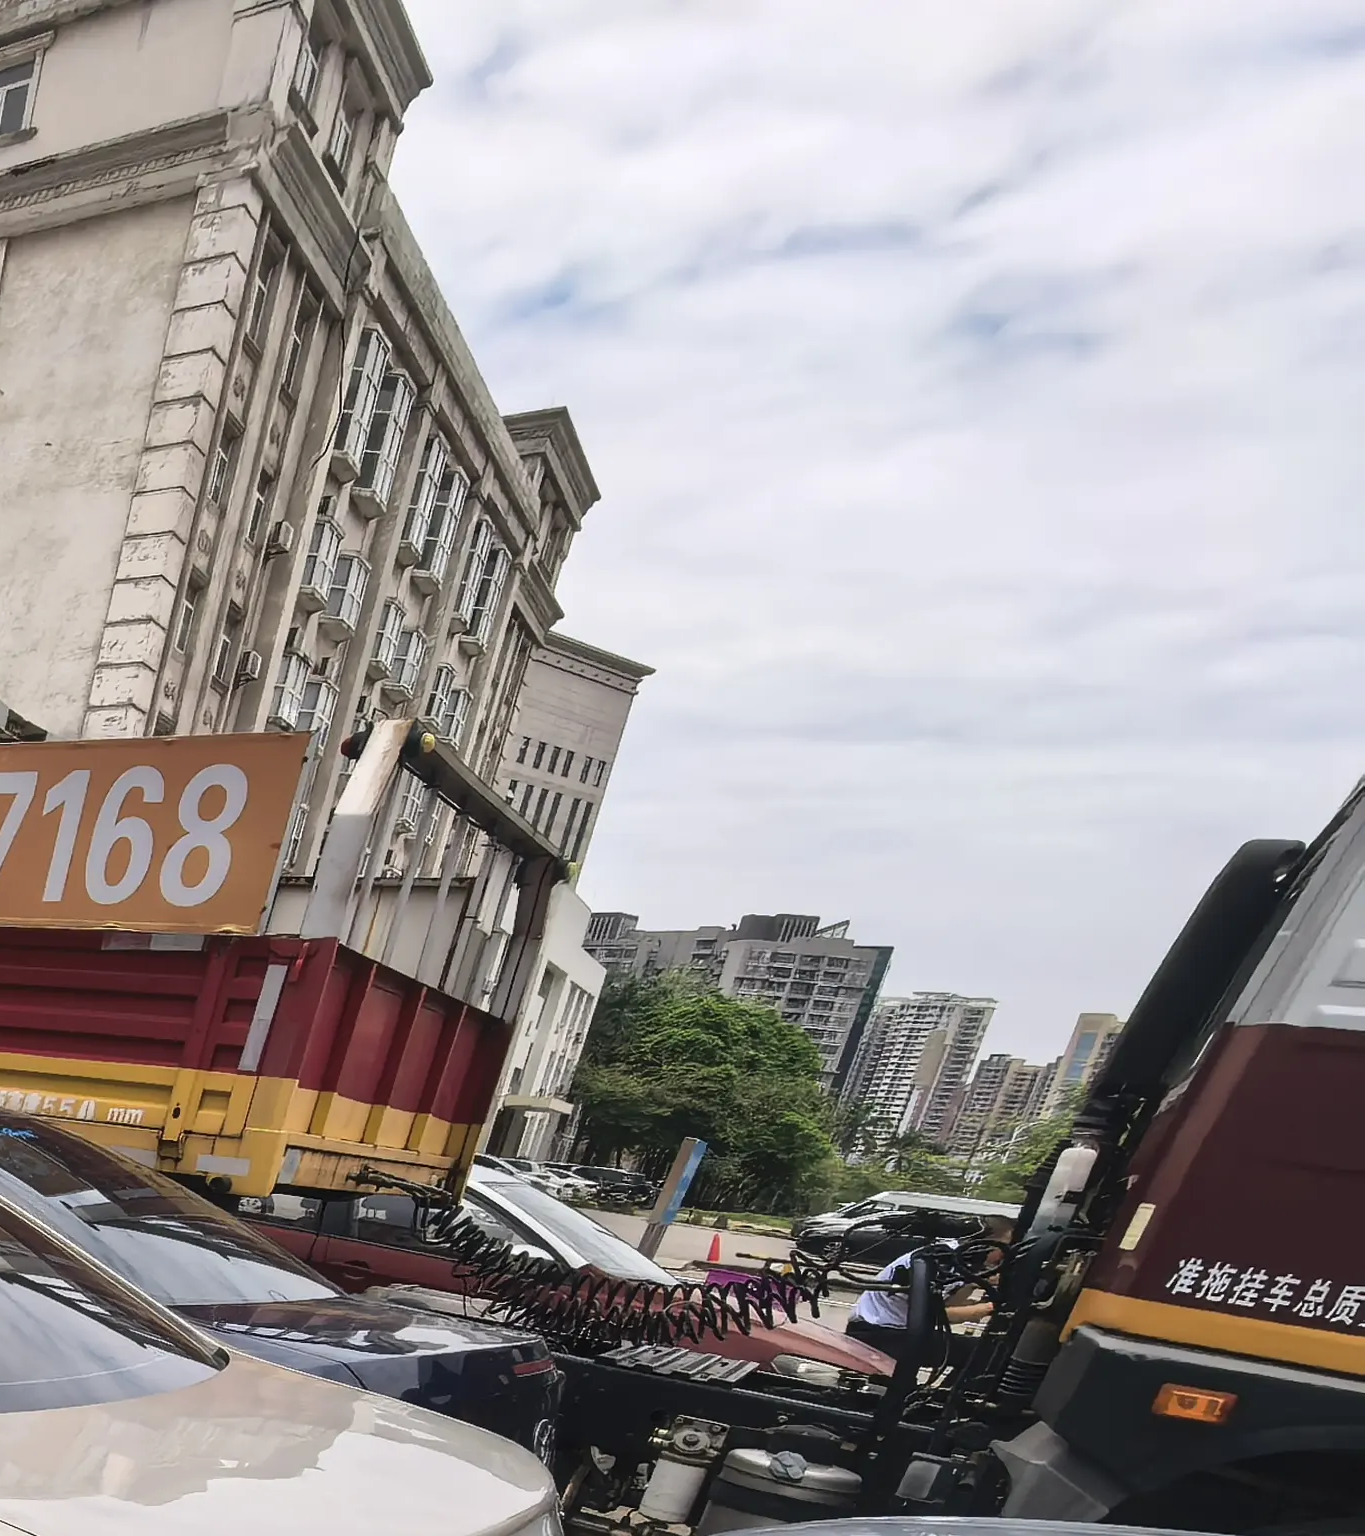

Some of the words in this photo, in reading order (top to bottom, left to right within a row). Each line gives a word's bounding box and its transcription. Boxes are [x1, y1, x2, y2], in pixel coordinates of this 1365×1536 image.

[1165, 1257, 1365, 1328] 准拖挂车总质
